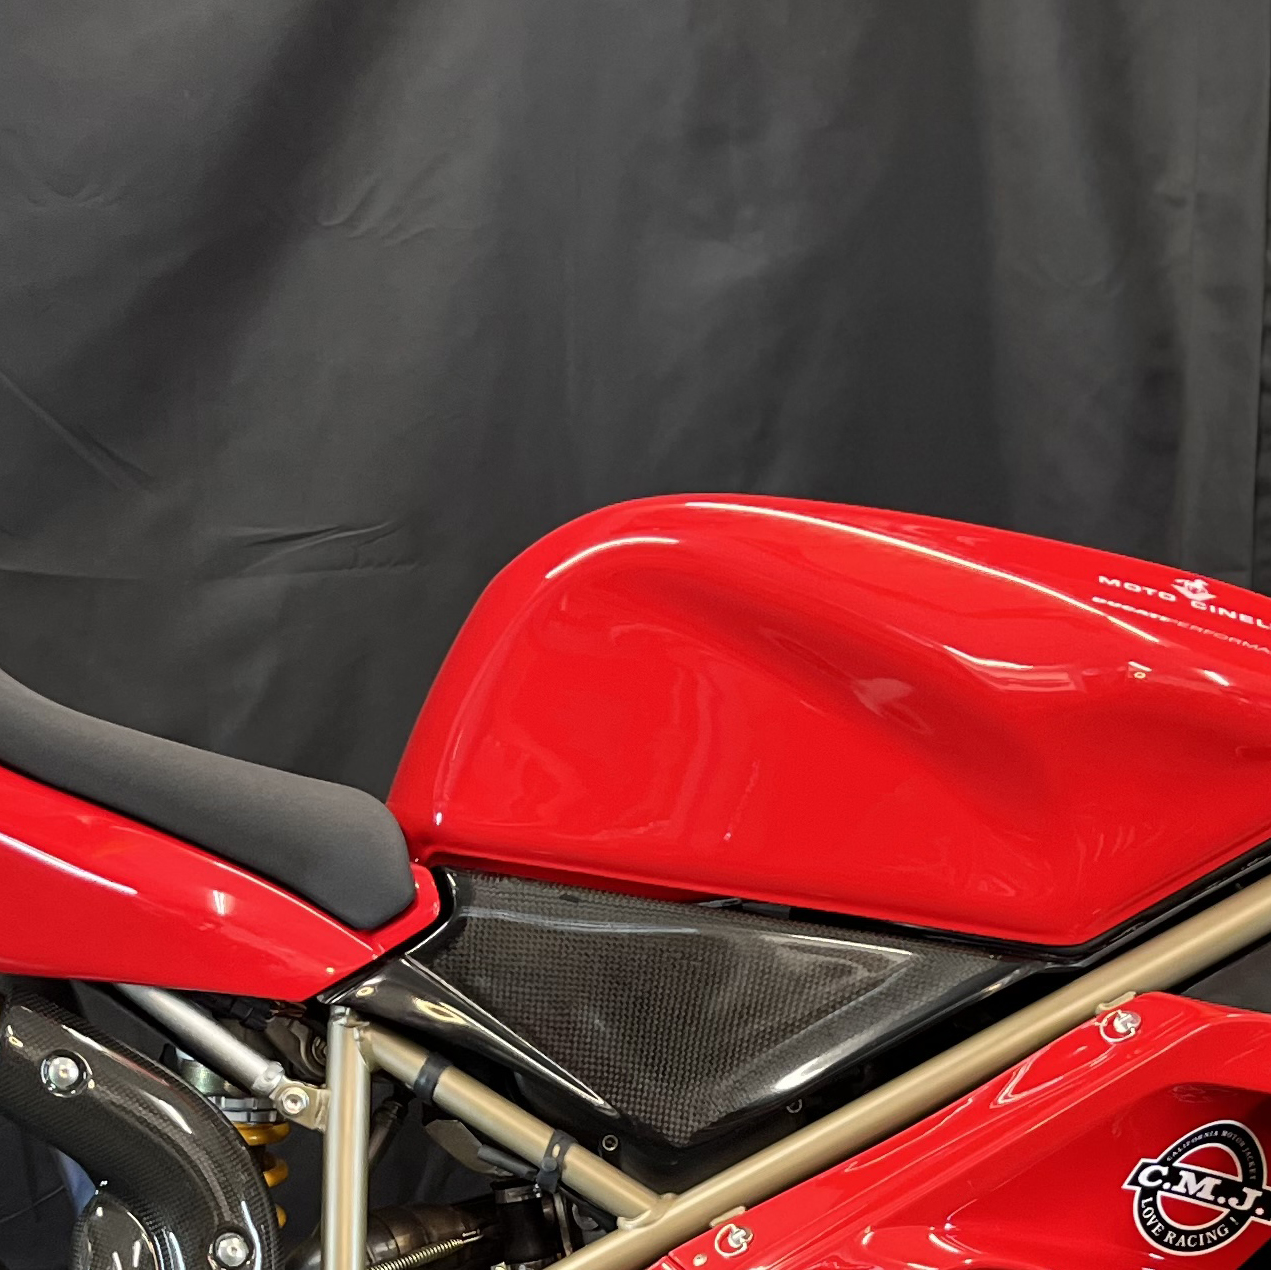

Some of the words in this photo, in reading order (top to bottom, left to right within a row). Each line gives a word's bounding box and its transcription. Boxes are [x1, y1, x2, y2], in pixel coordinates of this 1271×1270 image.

[1098, 575, 1177, 602] MOTO
[1137, 1164, 1265, 1216] C.M.J.
[1141, 1196, 1165, 1236] LOVE
[1164, 1223, 1230, 1248] RACING
